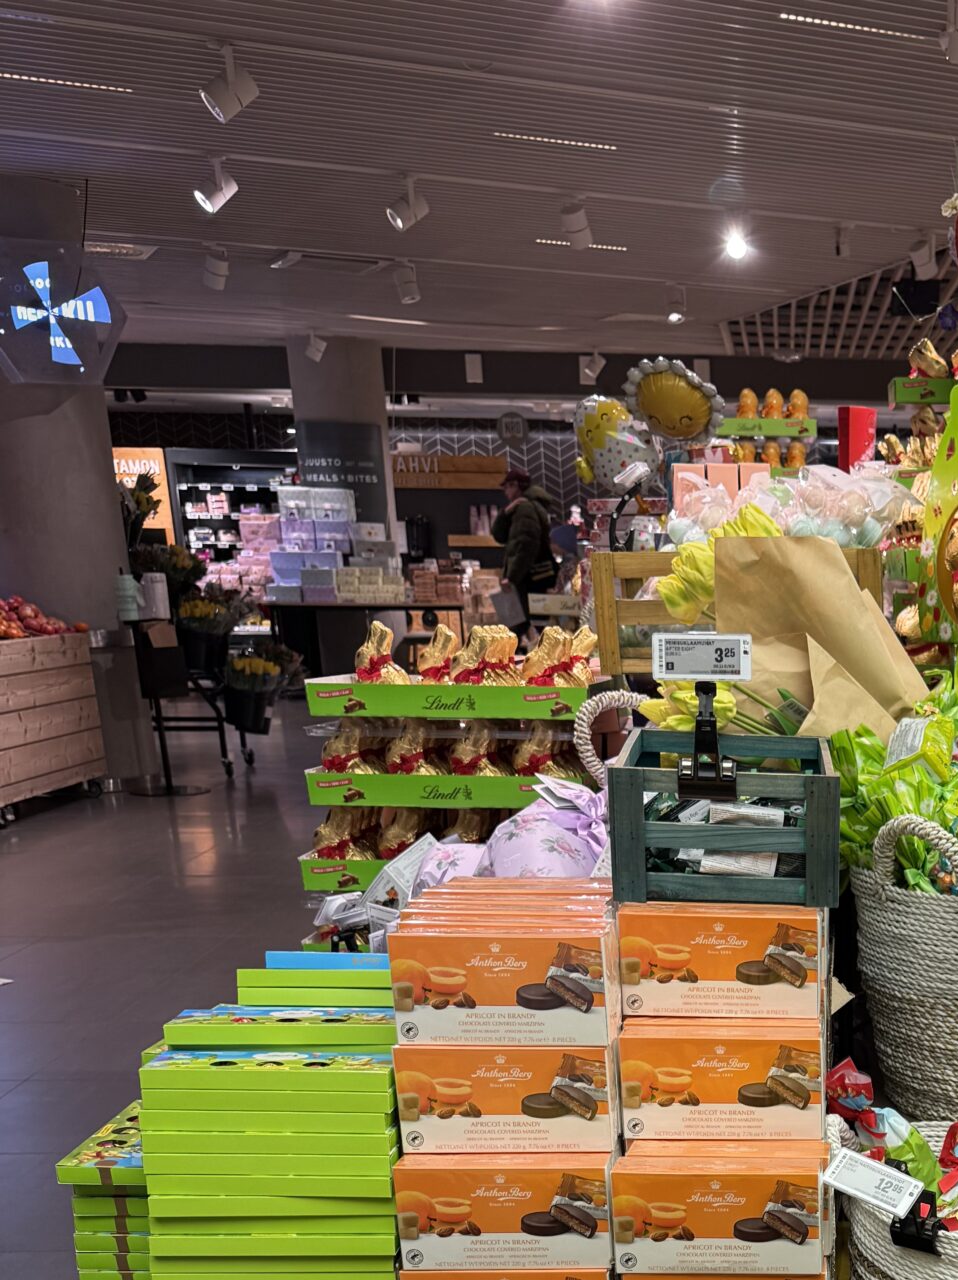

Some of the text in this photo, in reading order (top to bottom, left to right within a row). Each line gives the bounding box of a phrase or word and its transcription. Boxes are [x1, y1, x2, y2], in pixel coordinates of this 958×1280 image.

[303, 458, 342, 467] JUUSTO
[396, 457, 439, 473] AHVI
[305, 473, 337, 482] MEALS
[422, 694, 463, 711] Lindt
[420, 784, 463, 801] Lindt
[691, 935, 748, 949] Anthon Berg
[466, 956, 527, 970] Anthon Berg
[692, 1058, 750, 1071] Anthon Berg
[472, 1068, 532, 1081] Anthon Berg
[471, 1186, 532, 1200] Anthon Berg
[686, 1193, 746, 1206] Anthon Berg
